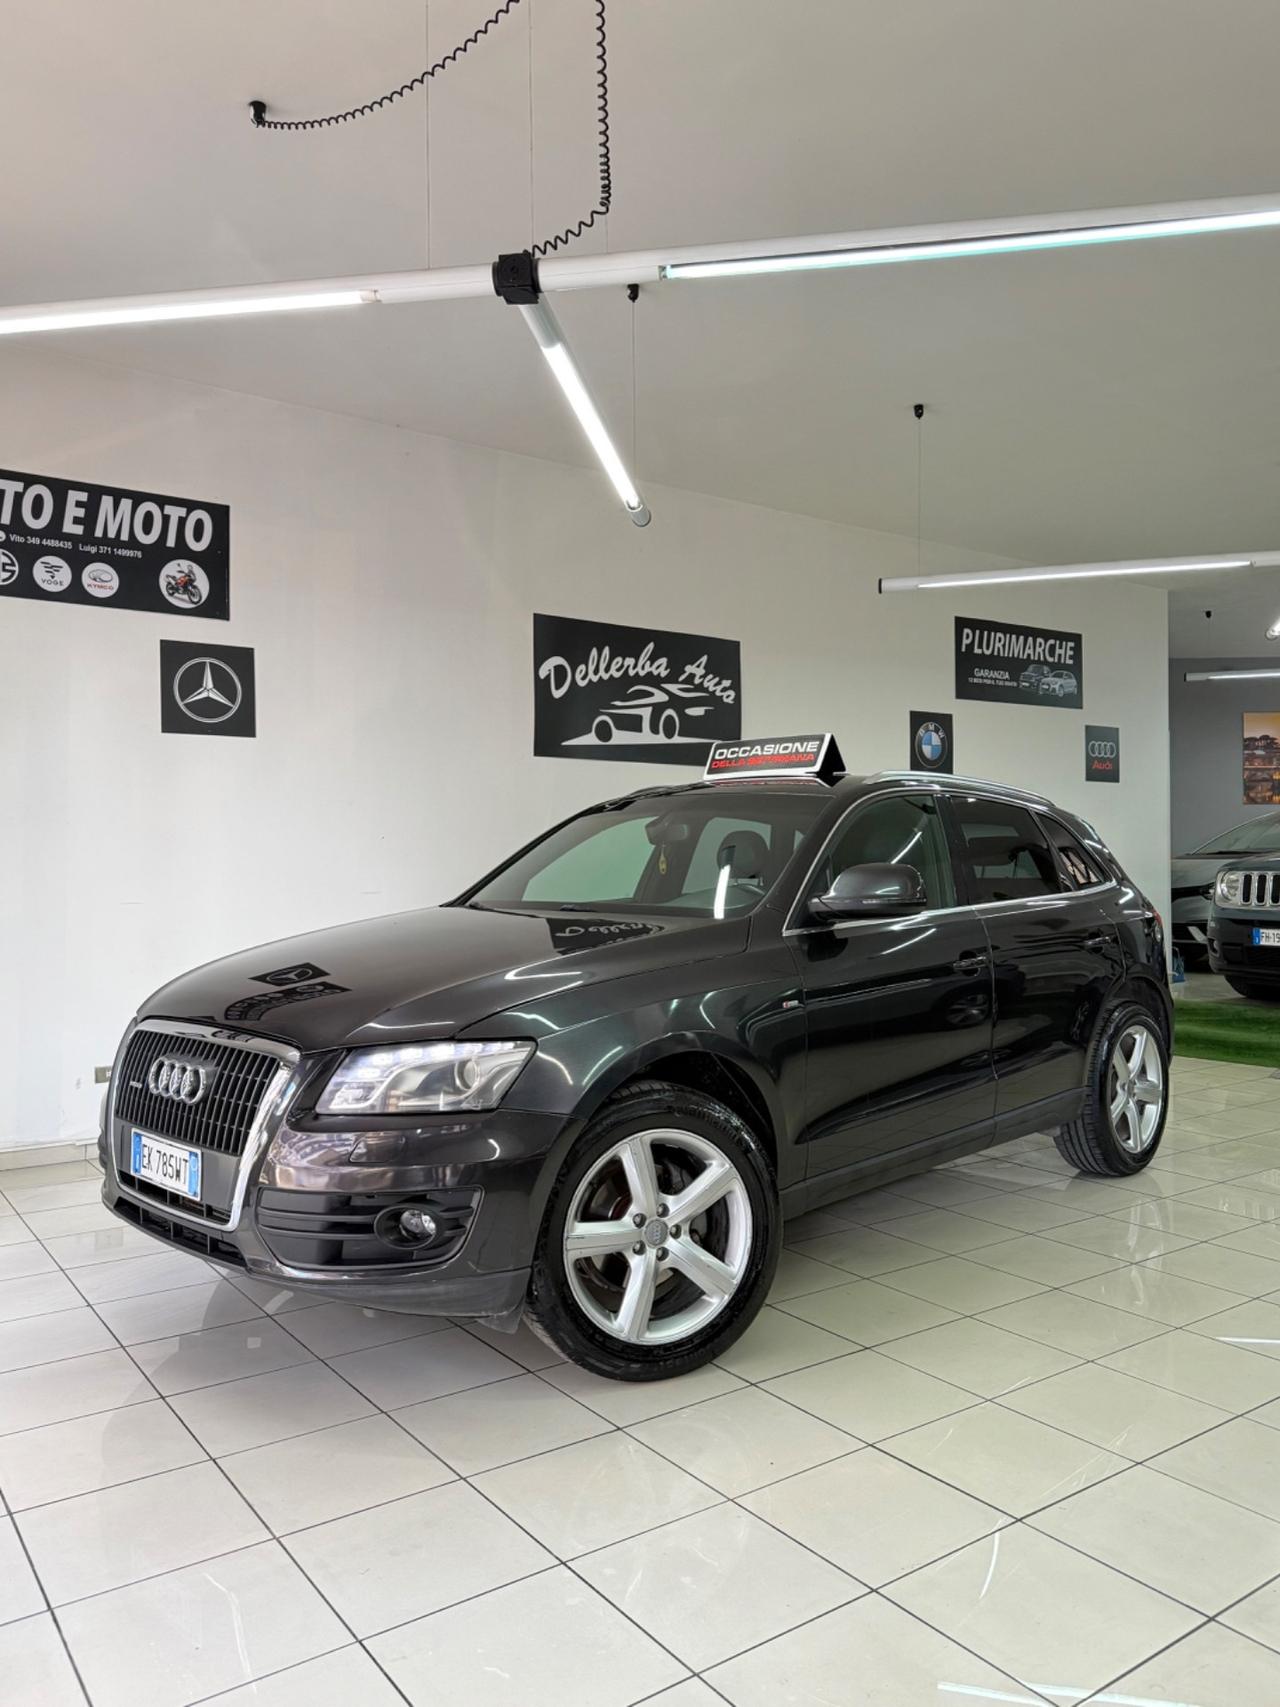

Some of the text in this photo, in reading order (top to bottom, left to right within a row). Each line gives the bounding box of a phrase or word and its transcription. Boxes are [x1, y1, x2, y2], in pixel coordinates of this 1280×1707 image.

[62, 489, 88, 535] E
[94, 494, 213, 552] MOTO
[9, 533, 25, 543] Vito
[26, 535, 40, 545] 349
[78, 543, 98, 554] Luigi
[98, 545, 111, 554] 371
[41, 578, 64, 587] VOGE
[961, 628, 1075, 665] PLURIMARCHE
[538, 641, 735, 704] Dellerba Auto
[974, 667, 1010, 680] GARANZIA
[918, 722, 945, 738] BMW
[714, 741, 819, 760] OCCASIONE
[711, 758, 746, 769] DELLA
[1092, 760, 1113, 770] Audi
